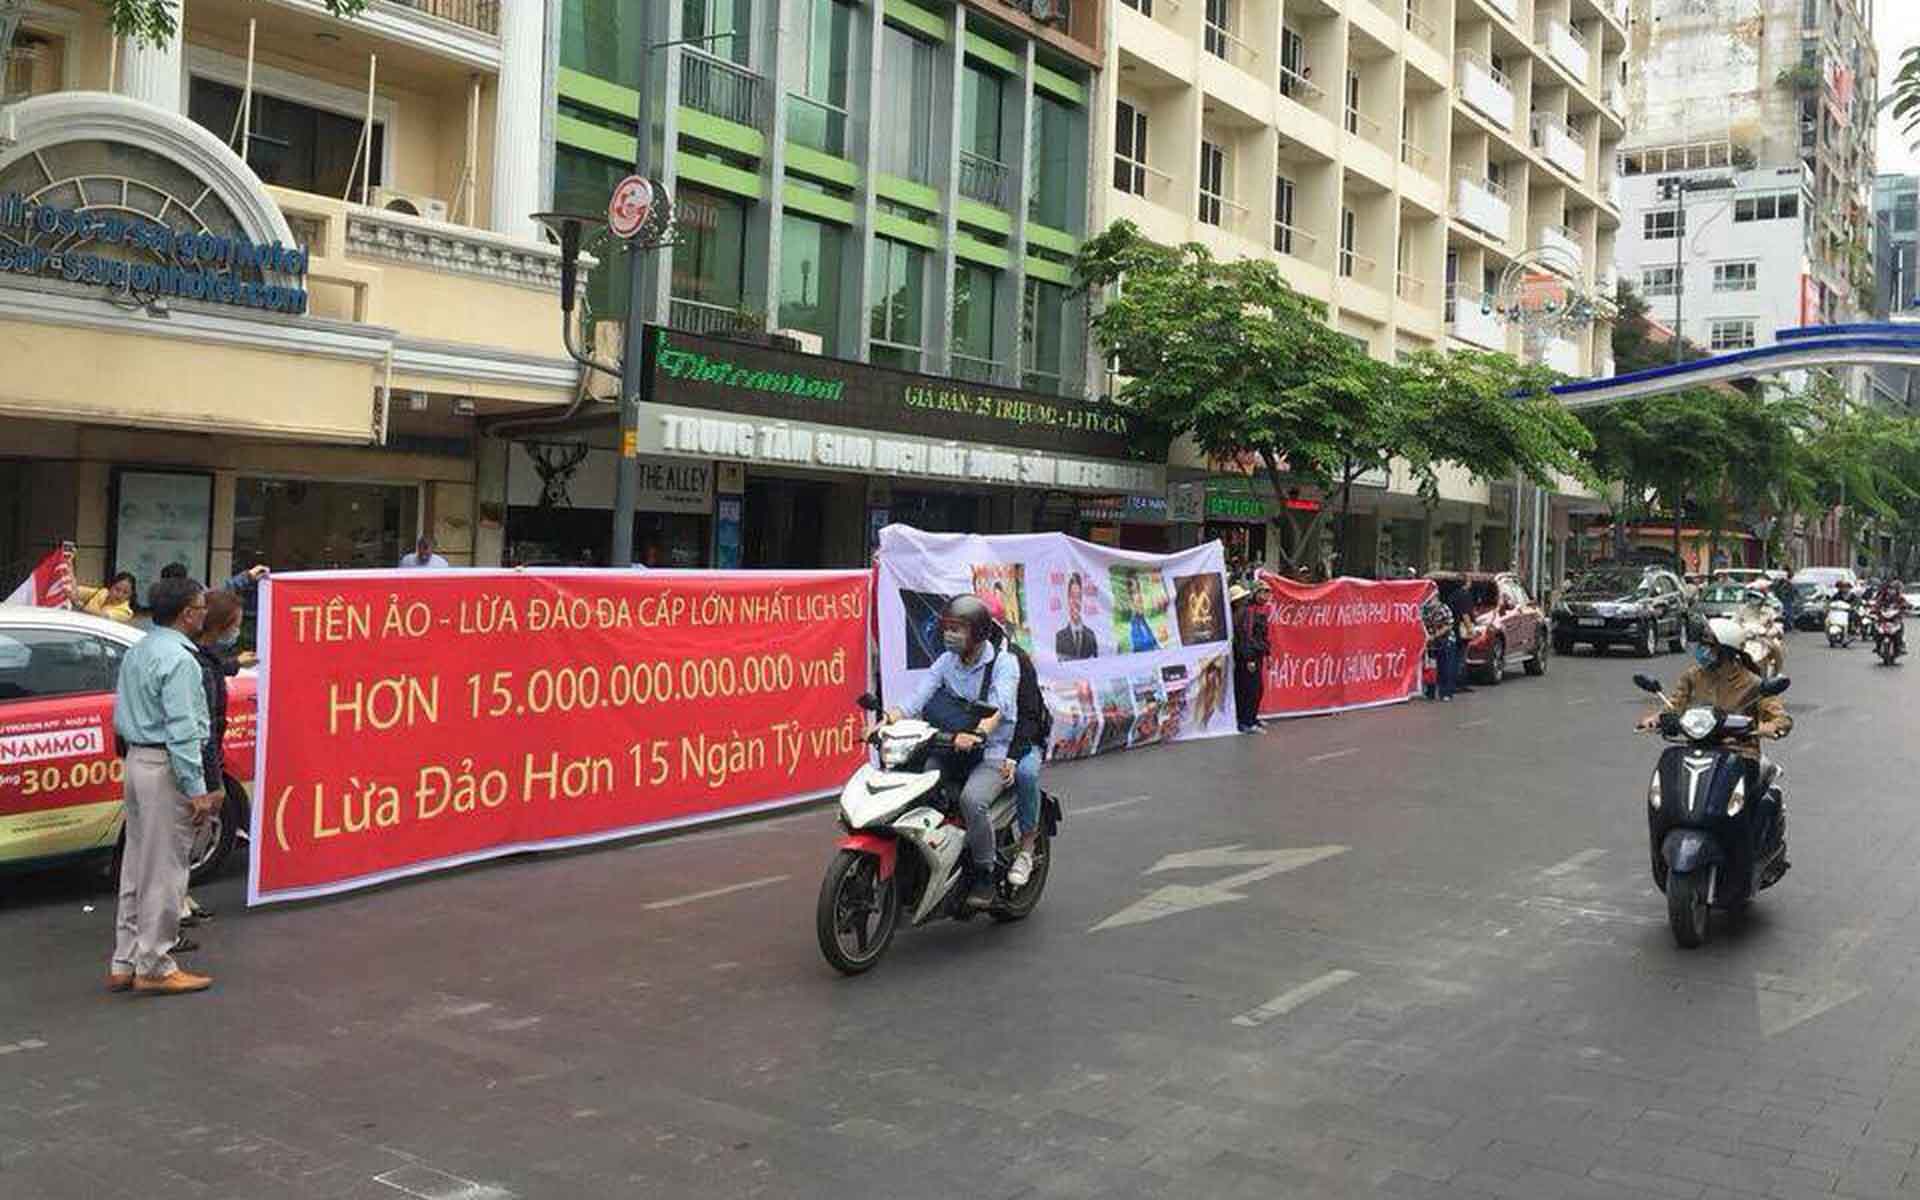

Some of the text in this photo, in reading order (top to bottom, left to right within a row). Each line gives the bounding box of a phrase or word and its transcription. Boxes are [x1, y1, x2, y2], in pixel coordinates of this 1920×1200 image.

[640, 463, 707, 493] THE ALLEY
[290, 594, 371, 642] TIỀN
[381, 593, 431, 639] ẢO
[459, 593, 518, 634] LỪA
[527, 589, 590, 631] ĐẢO
[596, 598, 632, 629] ĐA
[639, 588, 685, 627] CẤP
[691, 592, 734, 625] LỚN
[739, 586, 794, 624] NHẤT
[796, 593, 840, 625] LỊCH
[329, 647, 847, 735] HƠN 15.000.000.000.000 vnđ
[21, 761, 126, 795] 30.000
[314, 777, 400, 839] Lừa
[416, 757, 507, 819] Đảo
[523, 751, 614, 802] Hơn
[629, 741, 670, 788] 15
[681, 729, 765, 788] Ngàn
[771, 720, 803, 775] Tỷ
